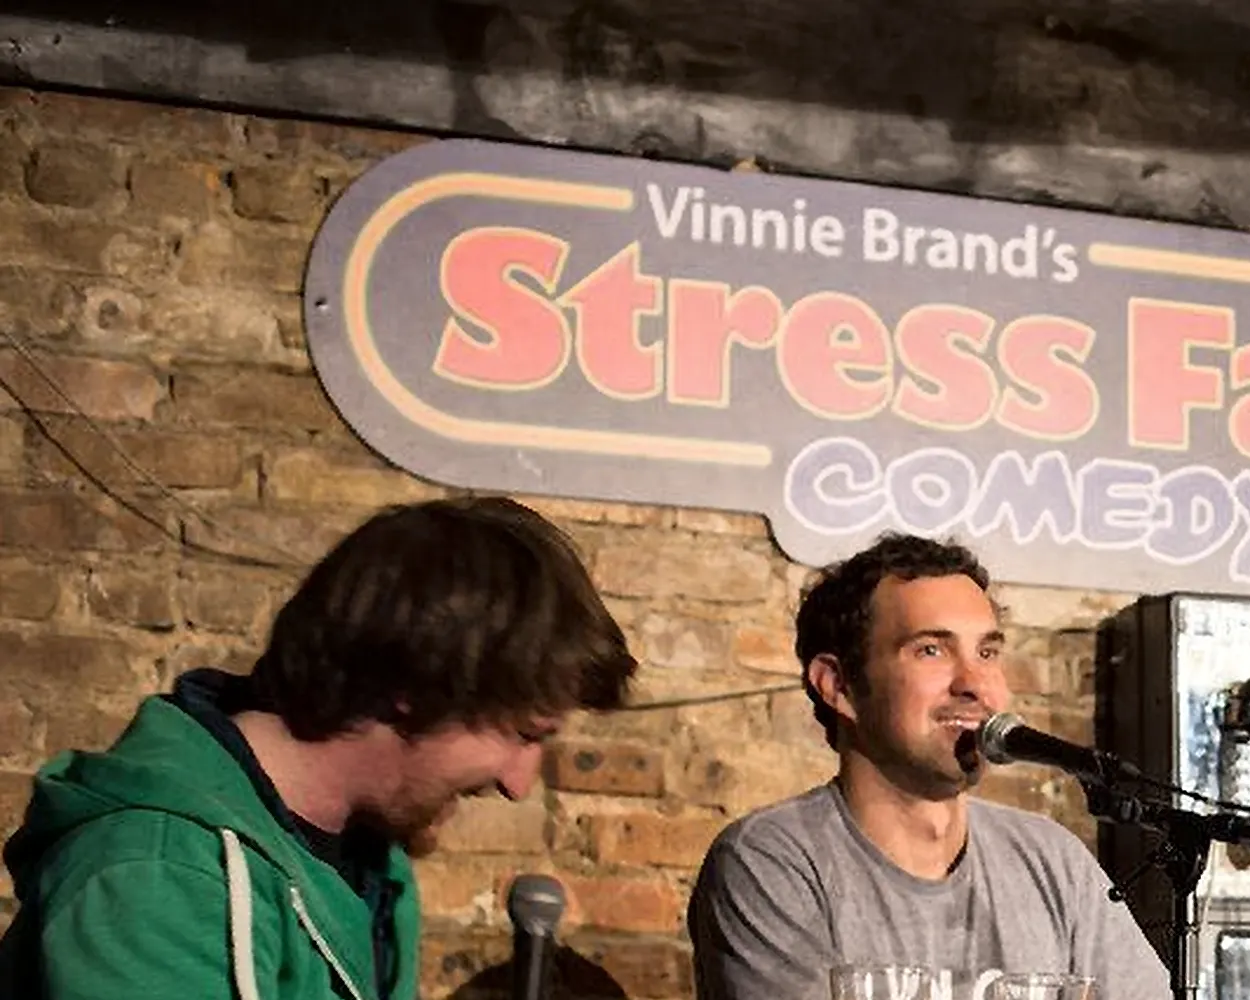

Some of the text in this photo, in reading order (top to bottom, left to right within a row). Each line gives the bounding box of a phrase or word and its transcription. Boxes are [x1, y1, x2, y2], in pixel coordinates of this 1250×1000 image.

[646, 182, 1080, 284] Vinnie Brand's
[432, 225, 1101, 442] Stress
